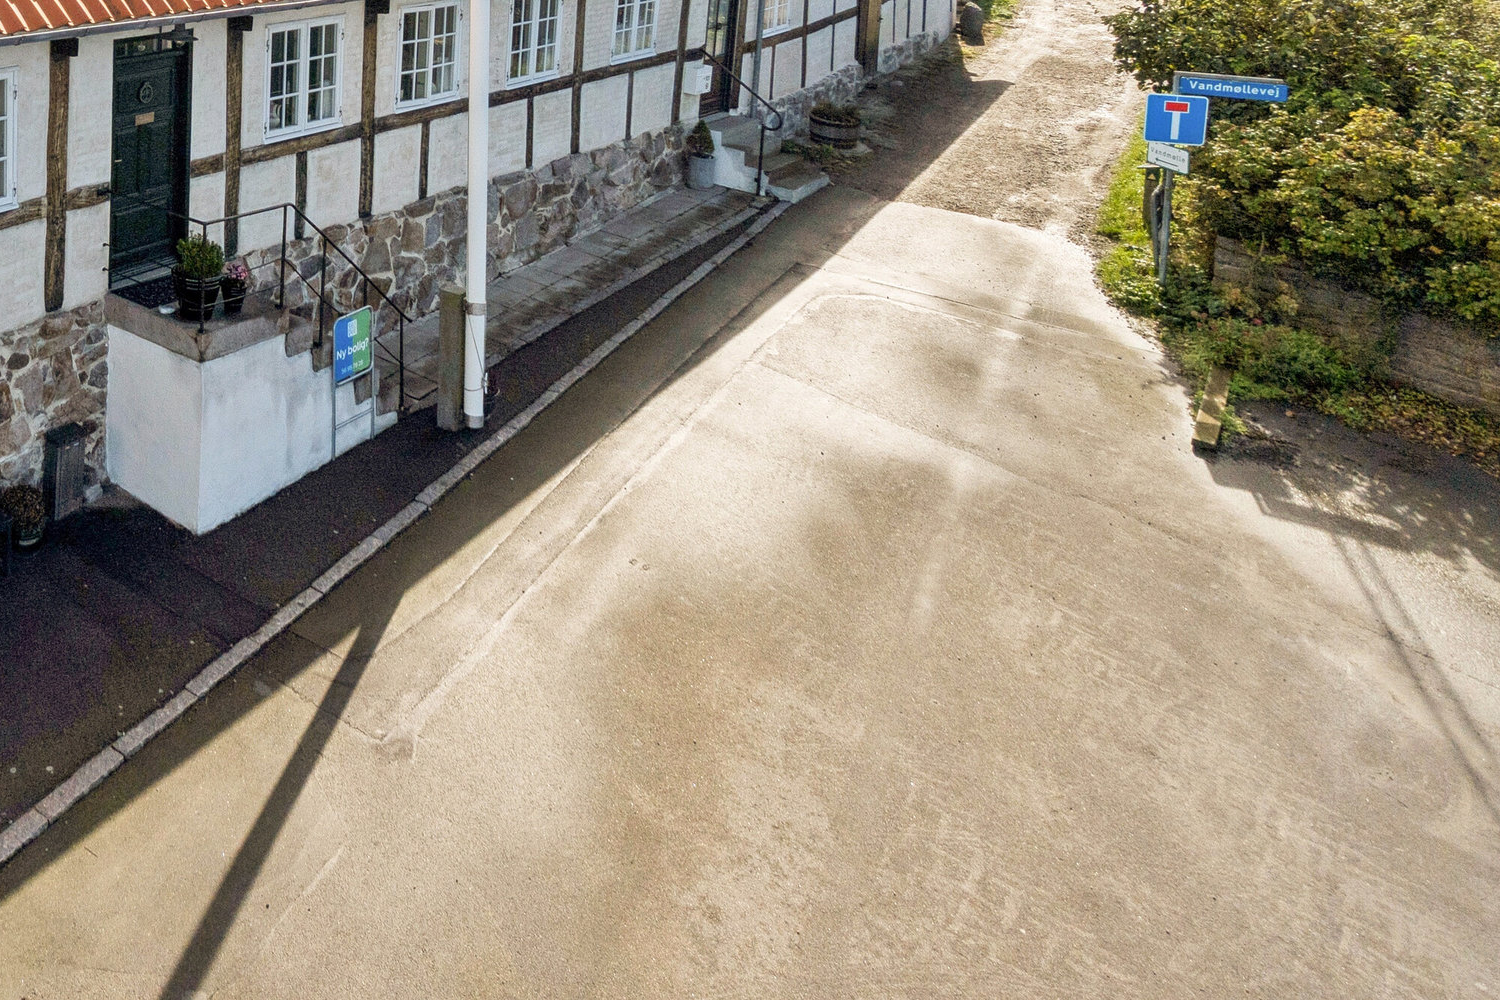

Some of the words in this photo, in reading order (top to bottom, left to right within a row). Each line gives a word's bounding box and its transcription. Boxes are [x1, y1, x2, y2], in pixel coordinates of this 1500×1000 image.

[1189, 80, 1280, 98] Vandmøllevej
[1150, 146, 1186, 163] Vandmølle
[336, 349, 347, 361] Ny
[347, 337, 369, 355] bolig?
